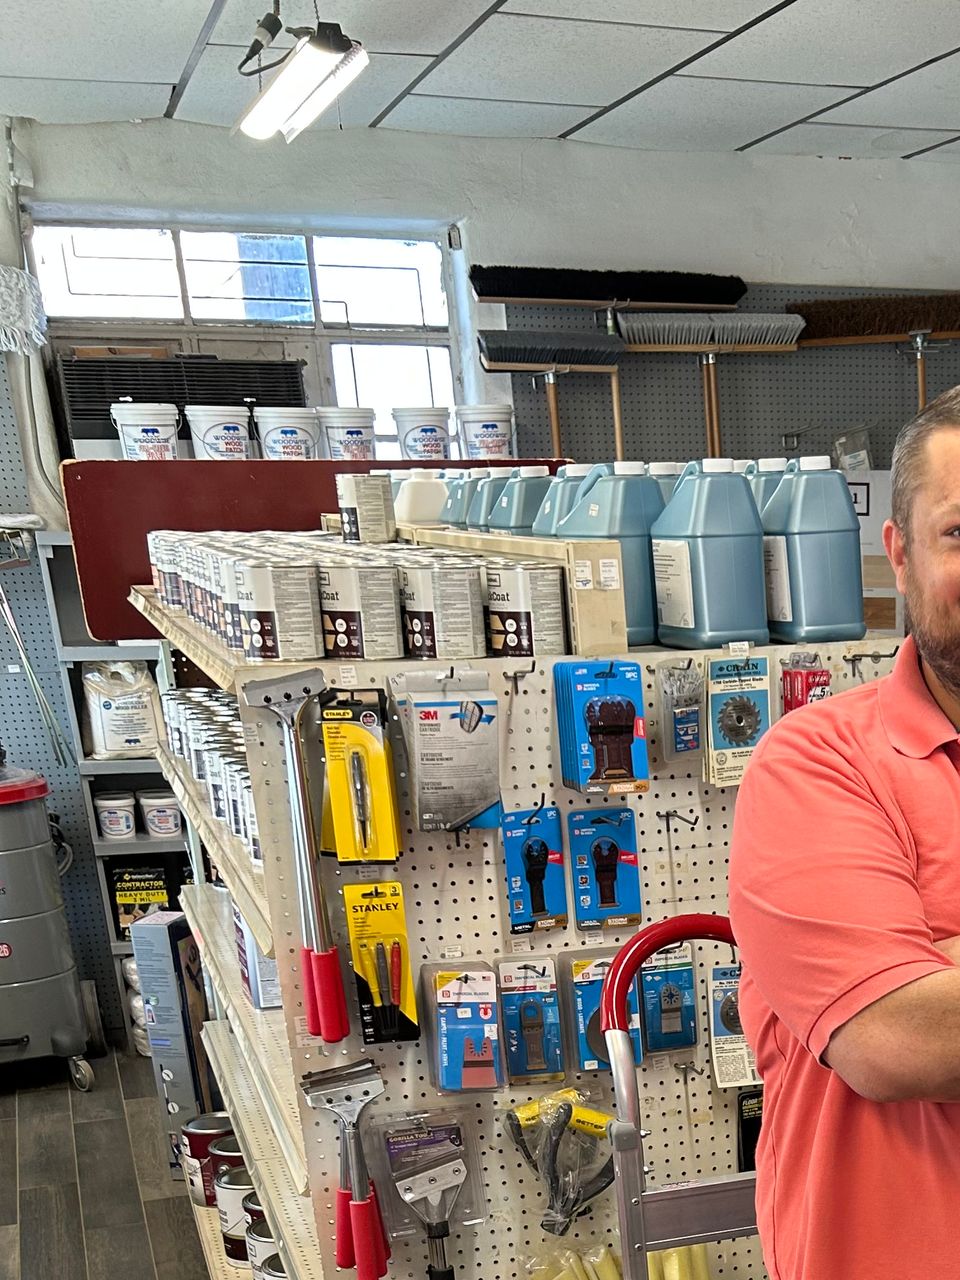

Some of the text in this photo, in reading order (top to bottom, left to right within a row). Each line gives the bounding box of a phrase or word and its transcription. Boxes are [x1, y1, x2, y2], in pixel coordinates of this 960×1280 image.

[320, 590, 340, 601] Coat
[726, 663, 759, 672] CRAIN
[419, 711, 438, 721] 3M
[117, 880, 164, 888] CONTRACTOR
[352, 902, 399, 913] STANLEY
[576, 1119, 604, 1130] BETTER
